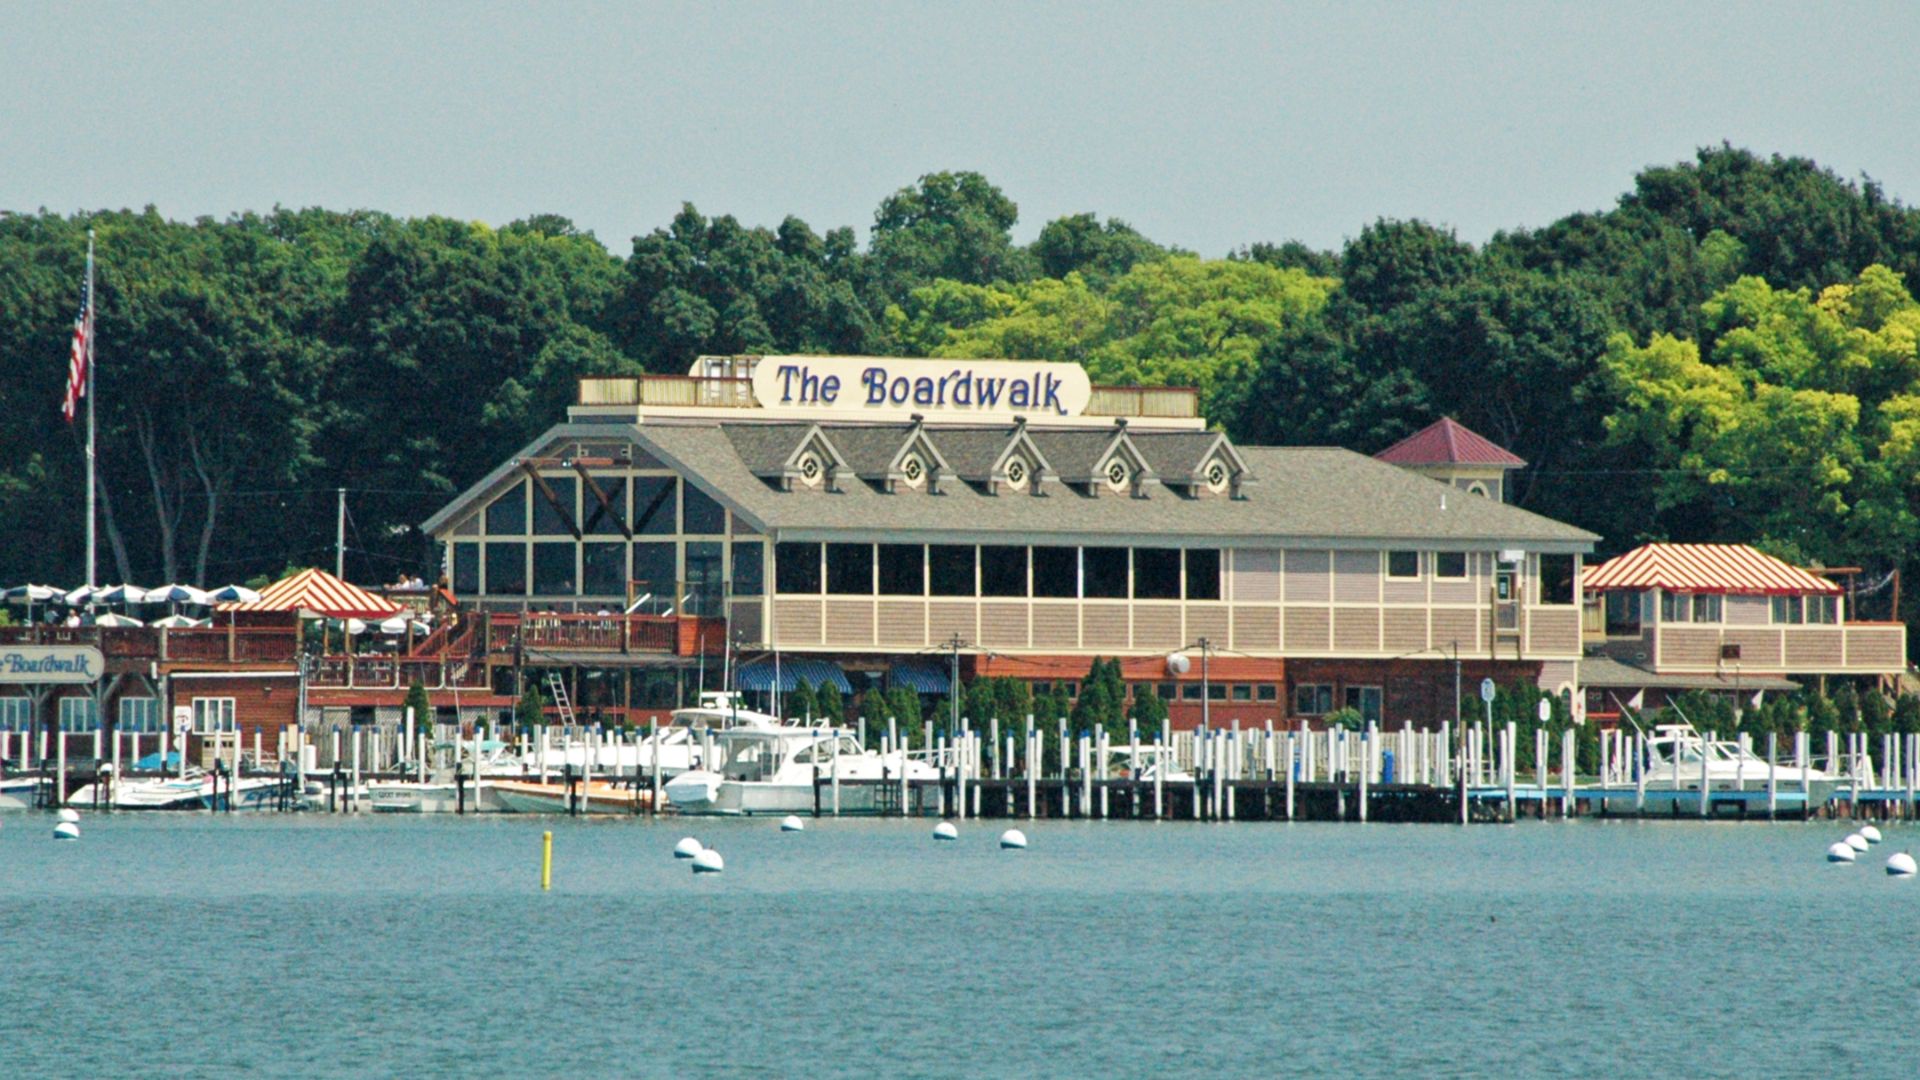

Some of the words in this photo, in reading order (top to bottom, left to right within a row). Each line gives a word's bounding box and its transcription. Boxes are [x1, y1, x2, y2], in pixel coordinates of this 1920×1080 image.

[776, 365, 841, 404] The
[861, 367, 1067, 416] Boardwalk
[4, 653, 95, 678] Boardwalk
